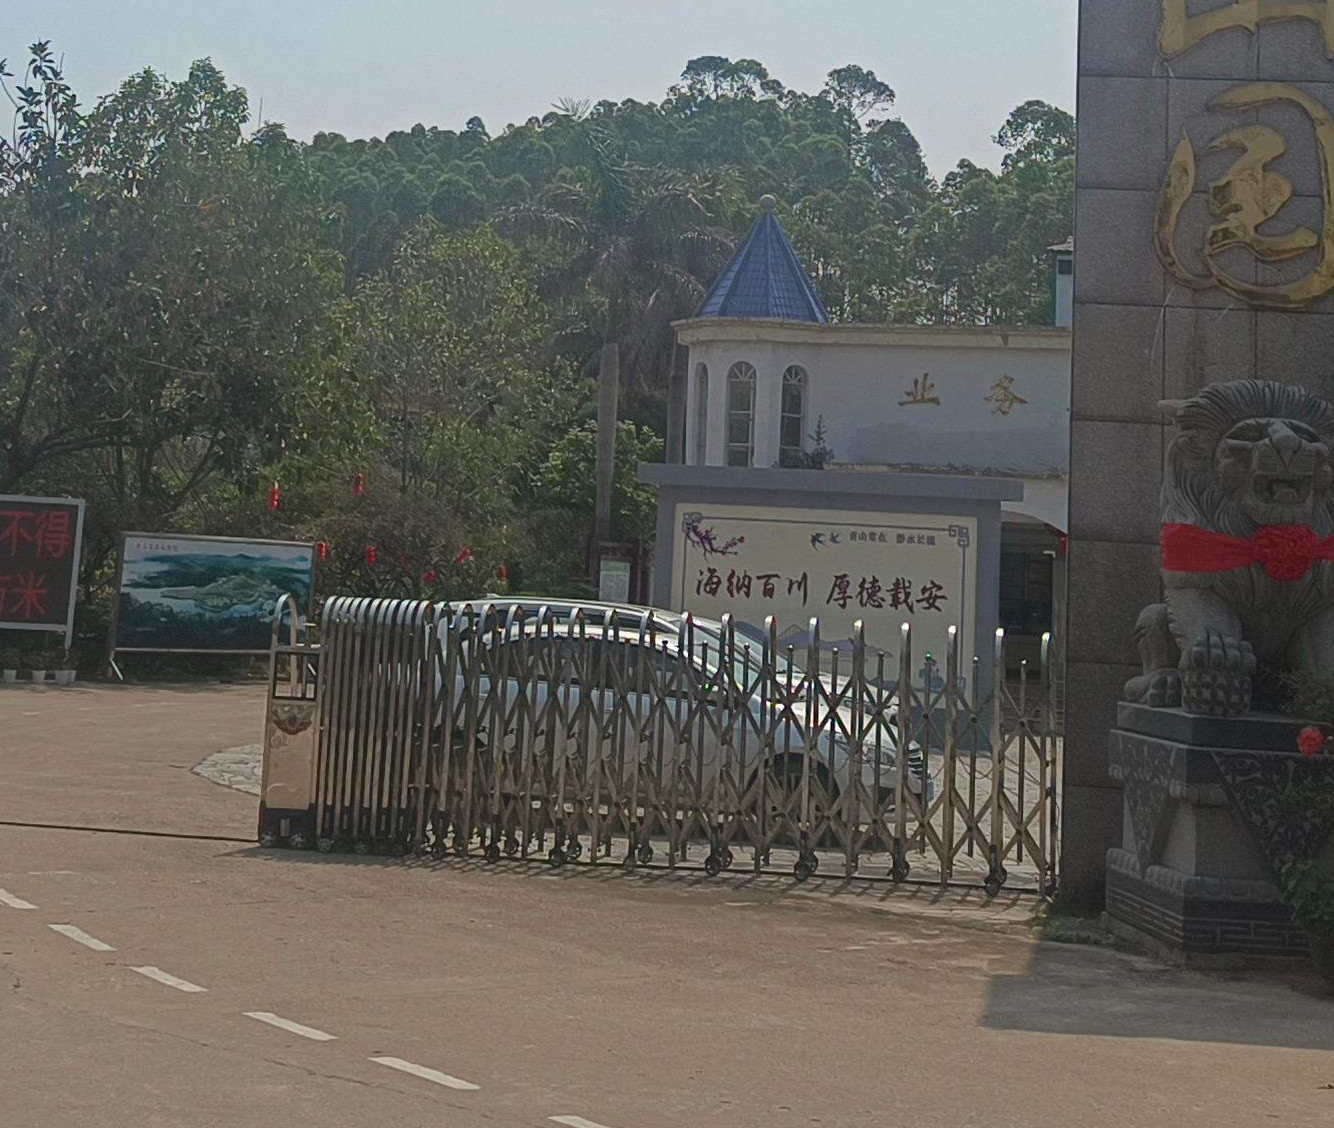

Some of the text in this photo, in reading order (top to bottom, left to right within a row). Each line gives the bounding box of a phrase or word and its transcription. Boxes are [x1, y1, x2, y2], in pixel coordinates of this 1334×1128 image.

[696, 566, 948, 614] 海纳百川 厚德载安
